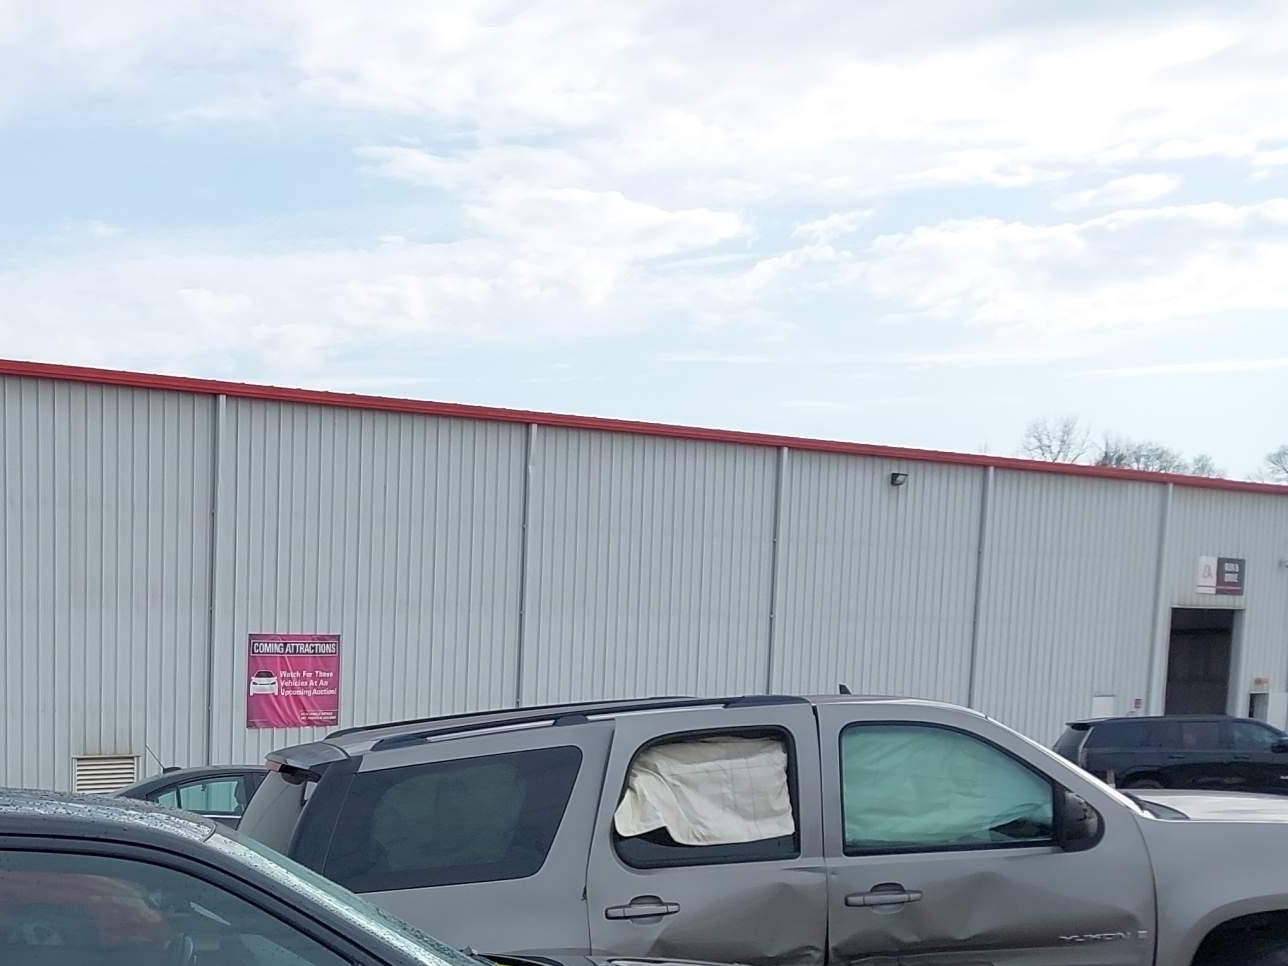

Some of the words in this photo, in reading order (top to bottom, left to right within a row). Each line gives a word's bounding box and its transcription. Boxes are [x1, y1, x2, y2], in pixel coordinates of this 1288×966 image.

[253, 642, 284, 653] COMING
[285, 642, 336, 653] ATTRACTIONS
[280, 688, 312, 696] Upcoming
